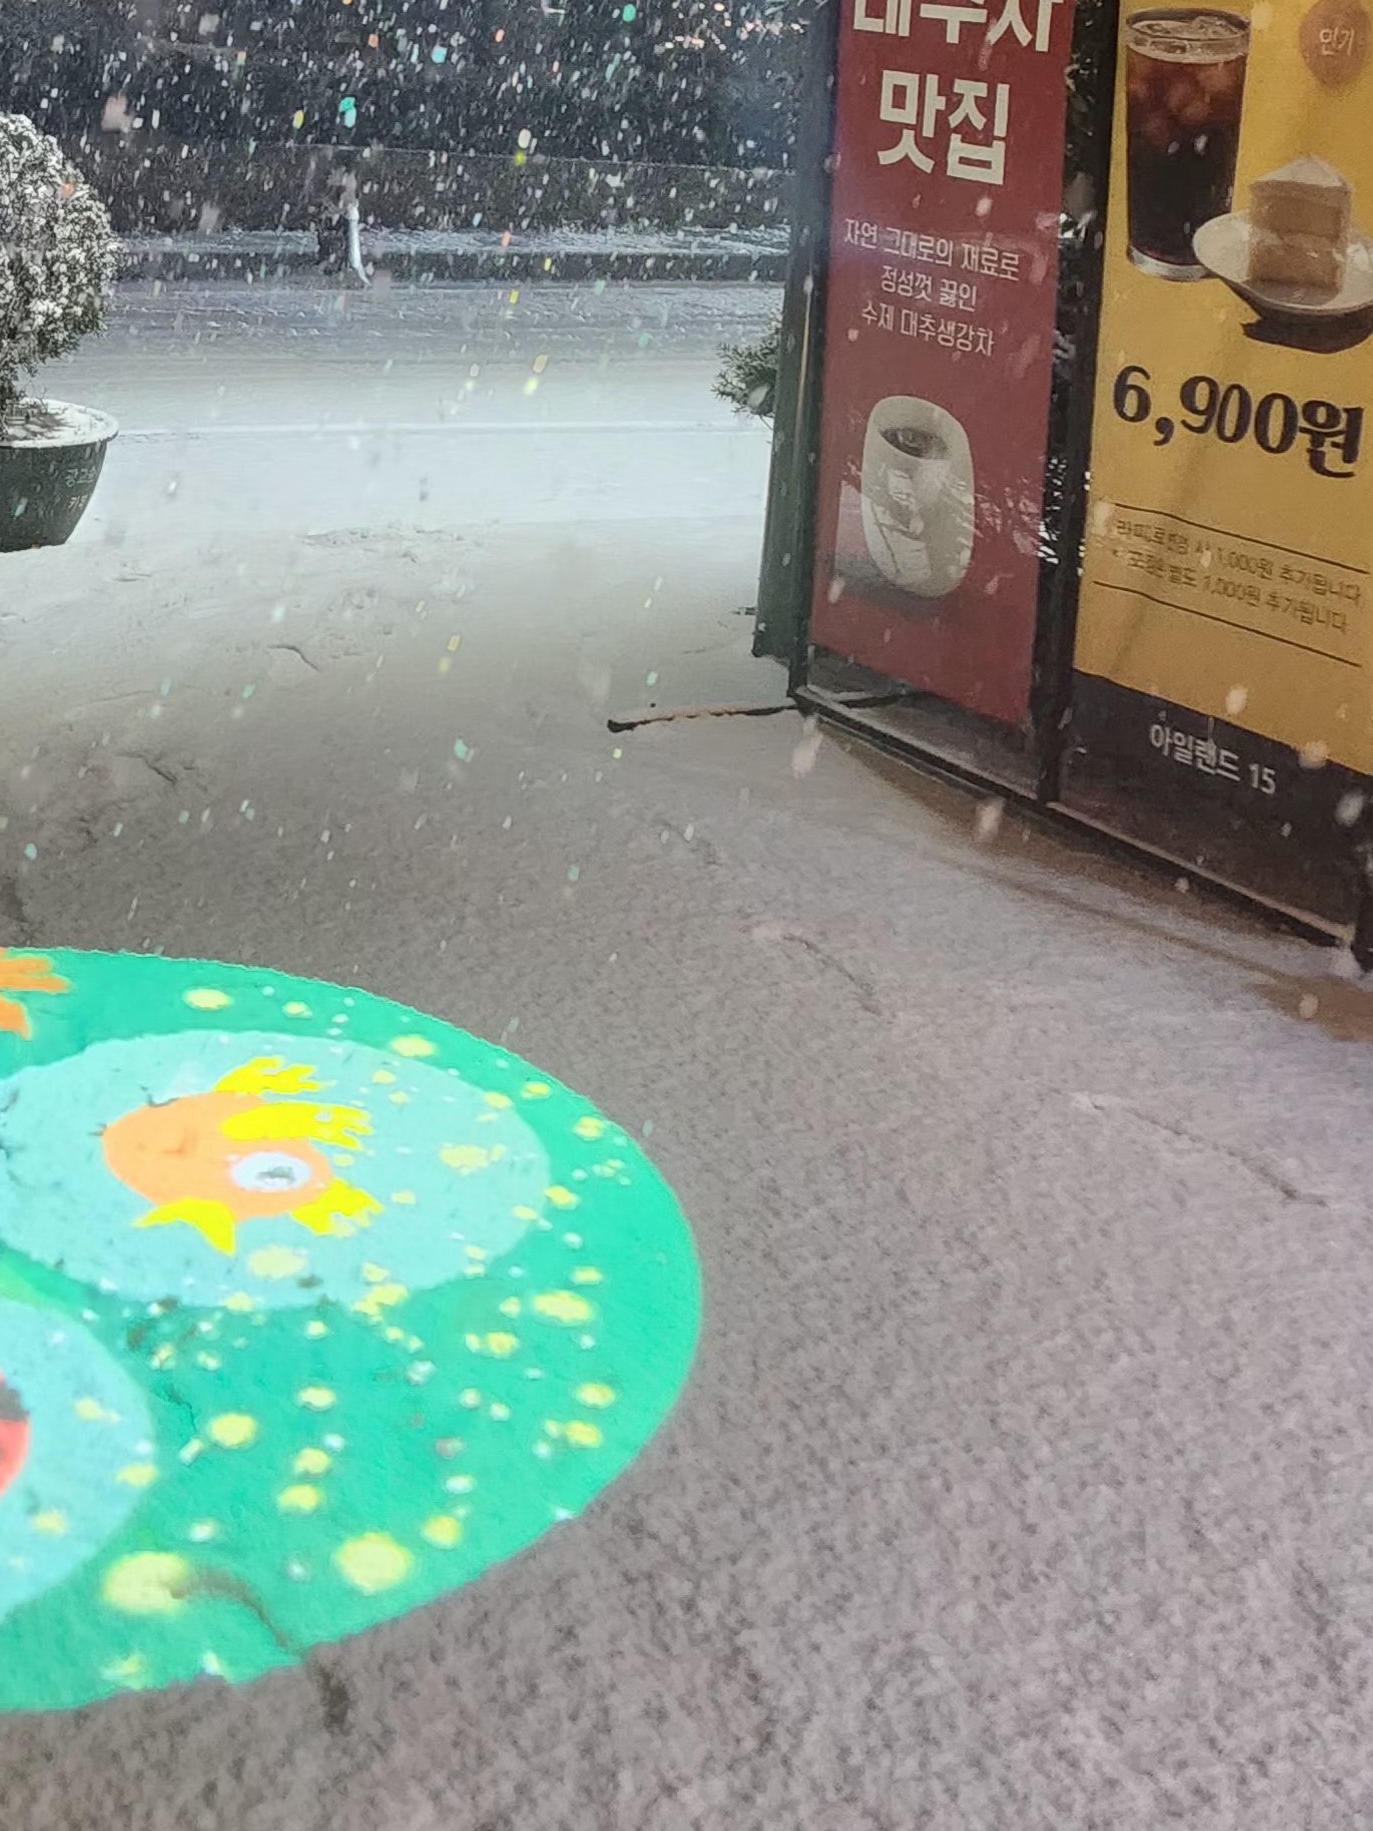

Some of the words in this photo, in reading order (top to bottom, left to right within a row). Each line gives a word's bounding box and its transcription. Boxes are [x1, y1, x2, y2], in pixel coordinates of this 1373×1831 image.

[1319, 26, 1355, 56] 인기
[877, 69, 1011, 186] 맛집
[844, 218, 878, 249] 자연
[883, 227, 954, 267] 그대로의
[960, 242, 1020, 282] 재료로
[880, 265, 933, 302] 정성껏
[939, 278, 977, 313] 끓인
[861, 300, 895, 332] 수제
[900, 308, 995, 357] 대추생강차
[1113, 364, 1365, 479] 6,900원
[1149, 723, 1241, 782] 아일랜드
[1248, 762, 1277, 795] 15
